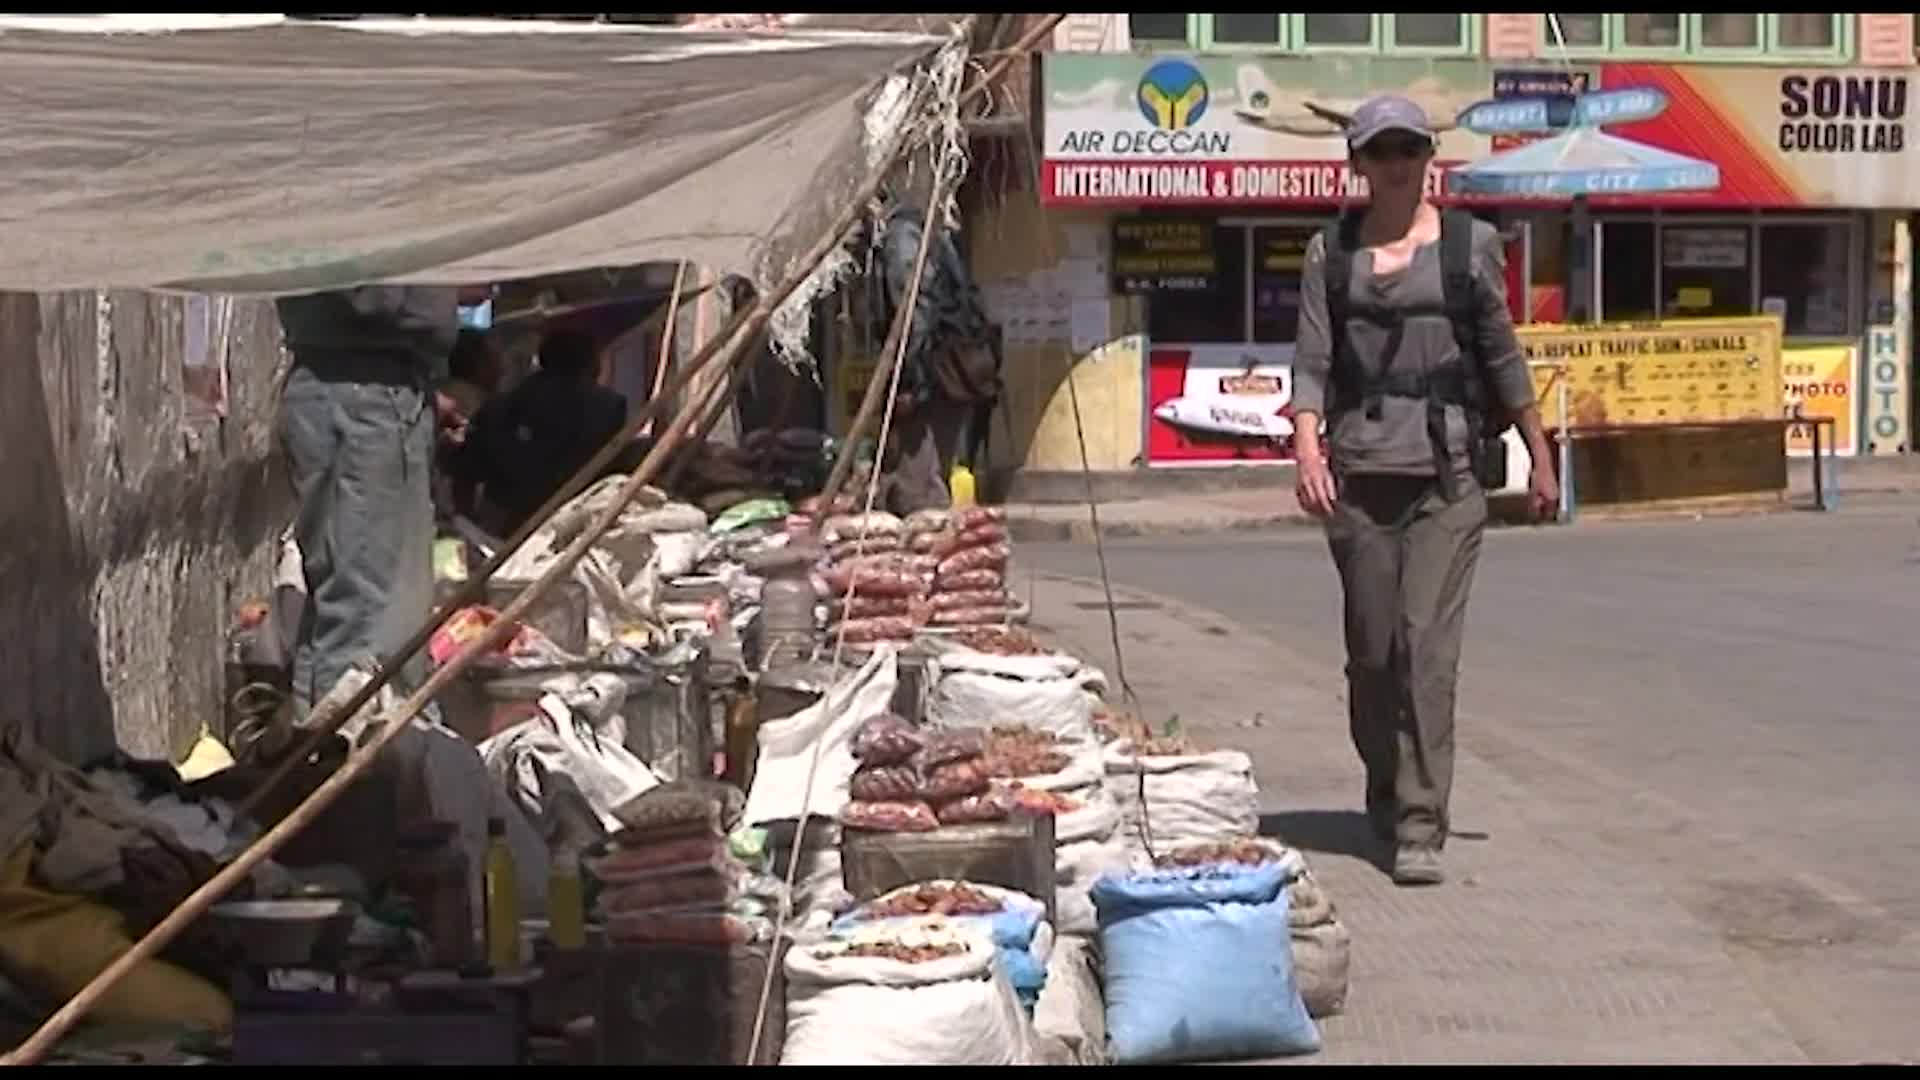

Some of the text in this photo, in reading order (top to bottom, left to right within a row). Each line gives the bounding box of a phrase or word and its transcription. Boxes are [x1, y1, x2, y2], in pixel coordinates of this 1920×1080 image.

[1781, 75, 1907, 119] SONU
[1059, 130, 1231, 152] AIR DECCAN
[1780, 123, 1905, 152] COLOR LAB
[1054, 166, 1209, 197] INTERNATIONAL
[1212, 170, 1230, 196] &
[1232, 166, 1335, 197] DOMESTIC
[1585, 174, 1640, 190] CITY
[1600, 336, 1649, 354] TRAFFIC
